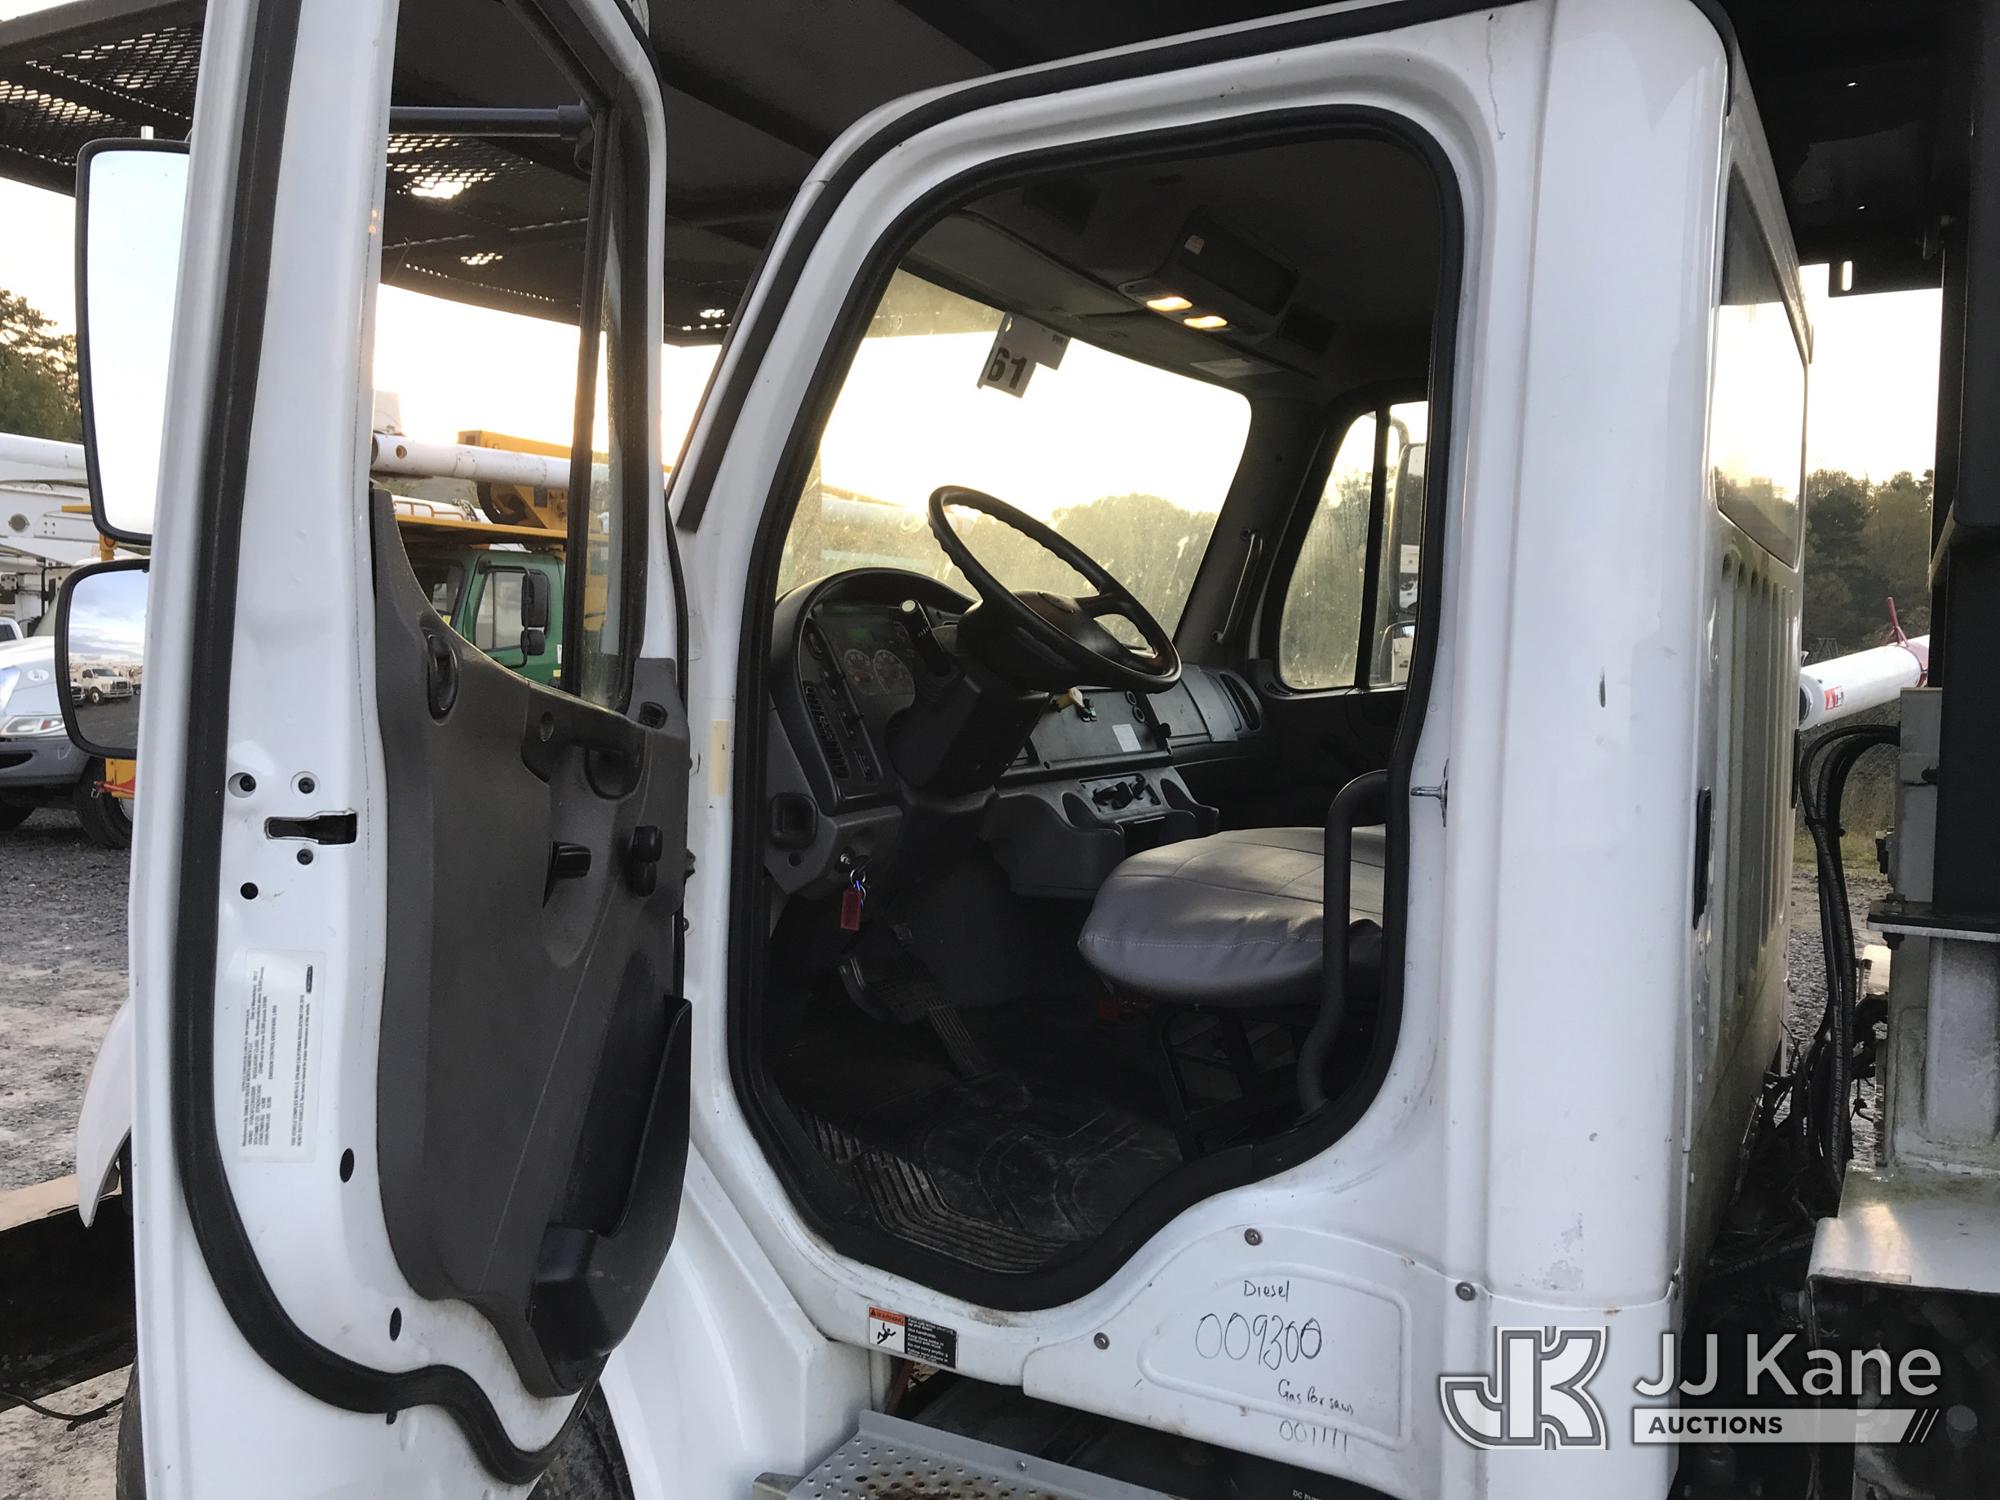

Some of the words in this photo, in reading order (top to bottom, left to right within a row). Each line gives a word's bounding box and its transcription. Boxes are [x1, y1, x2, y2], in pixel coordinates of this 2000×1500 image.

[987, 346, 1027, 390] 61
[1243, 1280, 1290, 1302] Diesel
[1195, 1312, 1323, 1371] 009300
